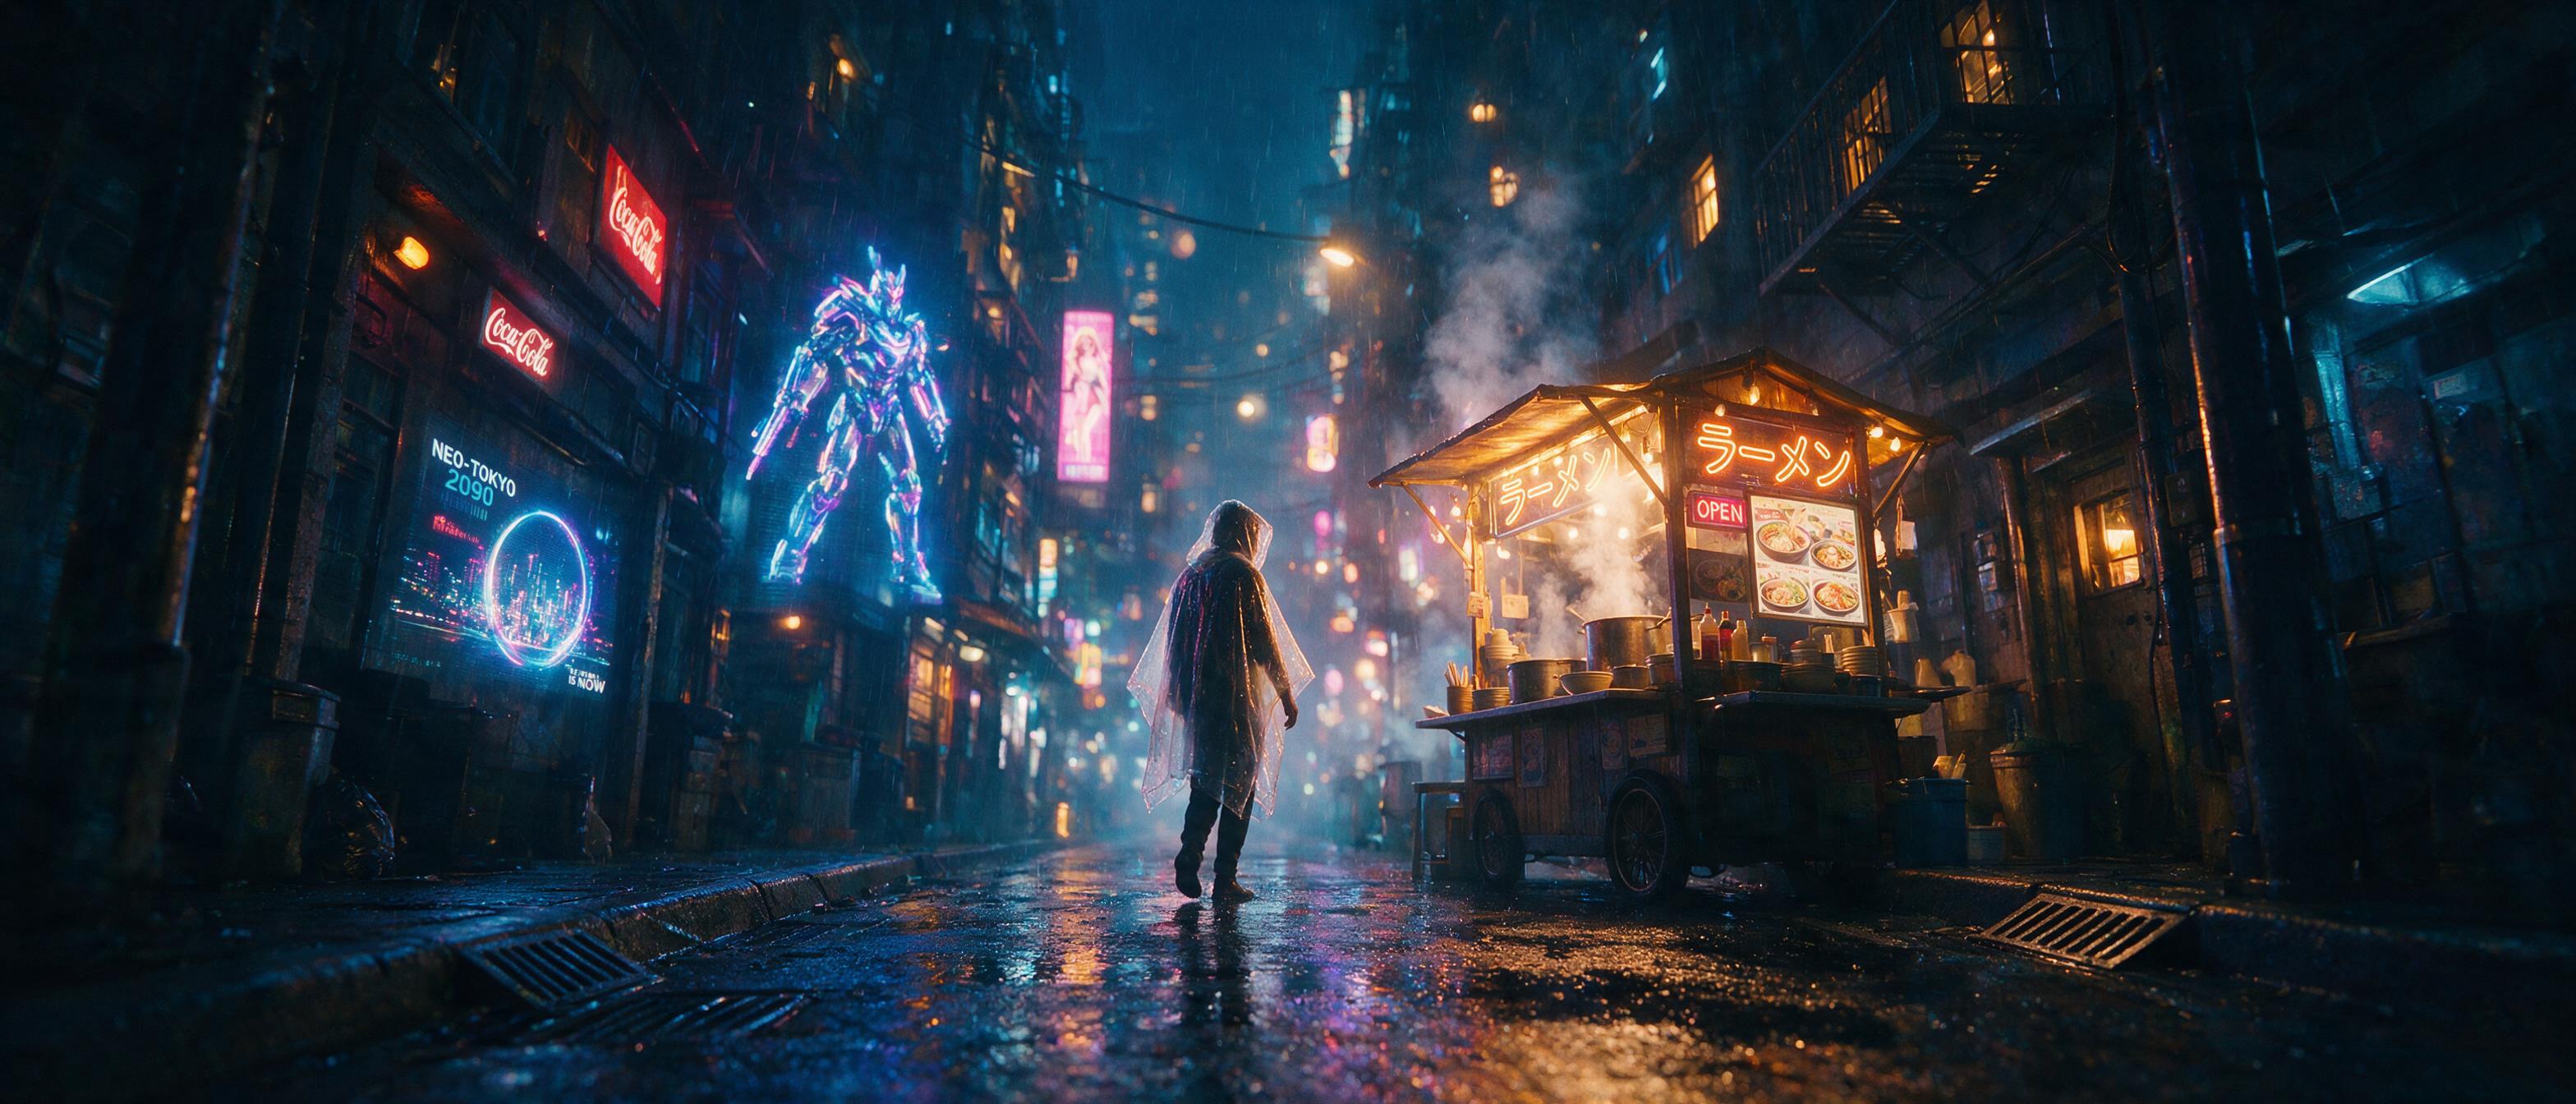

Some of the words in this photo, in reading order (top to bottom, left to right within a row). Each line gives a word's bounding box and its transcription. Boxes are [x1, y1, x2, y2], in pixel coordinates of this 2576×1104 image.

[485, 307, 554, 376] Coca-Cola
[432, 438, 516, 497] NEO-TOKYO
[1698, 423, 1850, 487] ラーメン
[445, 468, 494, 506] 2090
[1500, 448, 1611, 526] ラーメン
[1697, 499, 1743, 523] OPEN
[568, 675, 577, 685] IS
[577, 677, 606, 694] NOW
